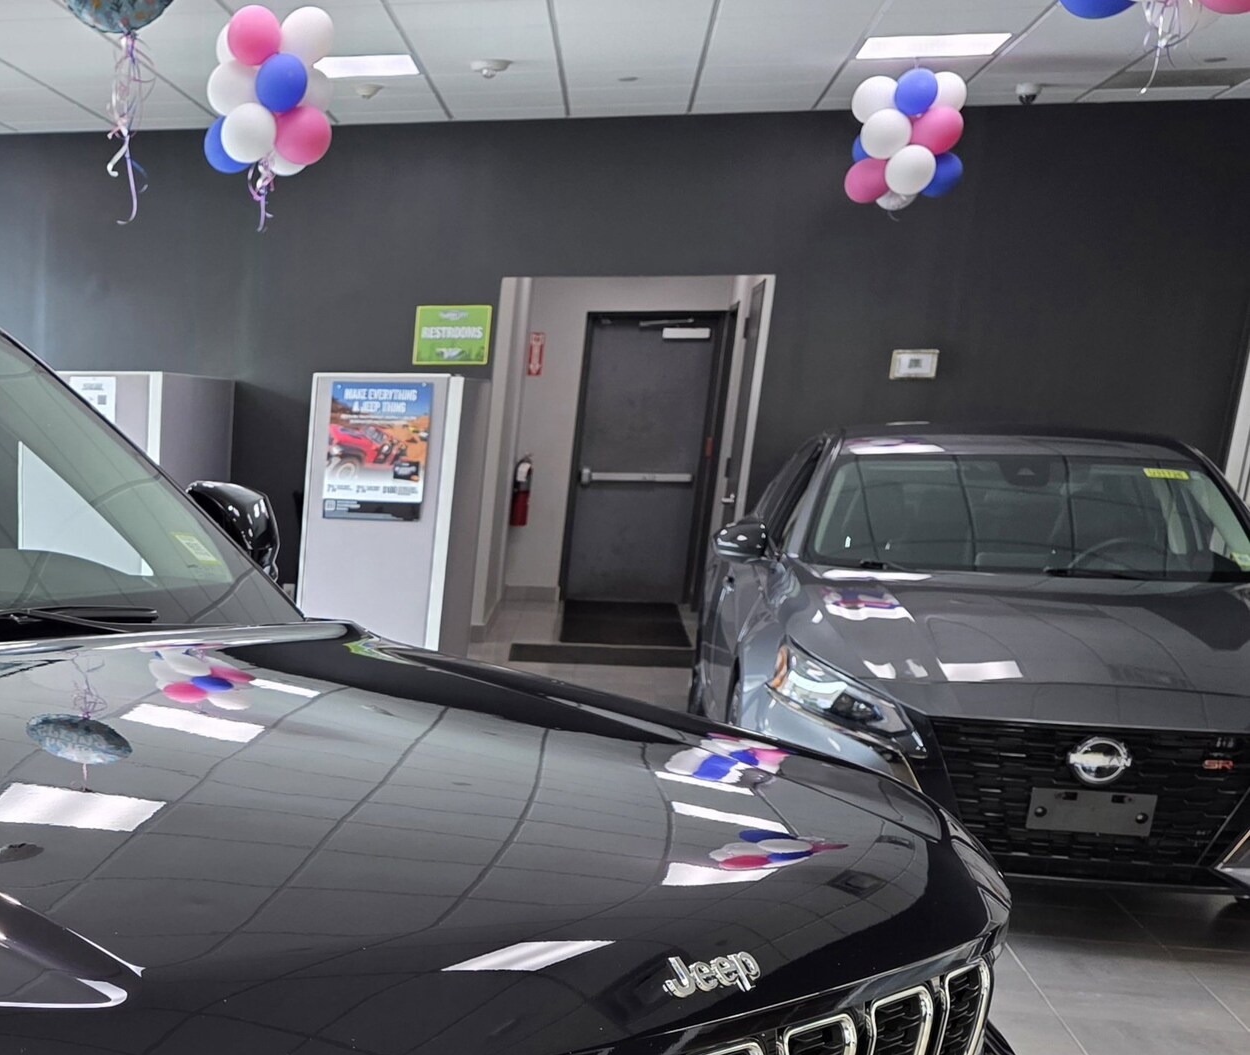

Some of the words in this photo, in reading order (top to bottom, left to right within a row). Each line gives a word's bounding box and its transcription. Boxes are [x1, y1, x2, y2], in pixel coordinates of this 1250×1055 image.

[421, 326, 483, 339] RESTROOMS
[344, 388, 367, 400] MAKE
[368, 388, 417, 401] EVERYTHING
[381, 402, 406, 413] THING
[662, 951, 761, 997] Jeep
